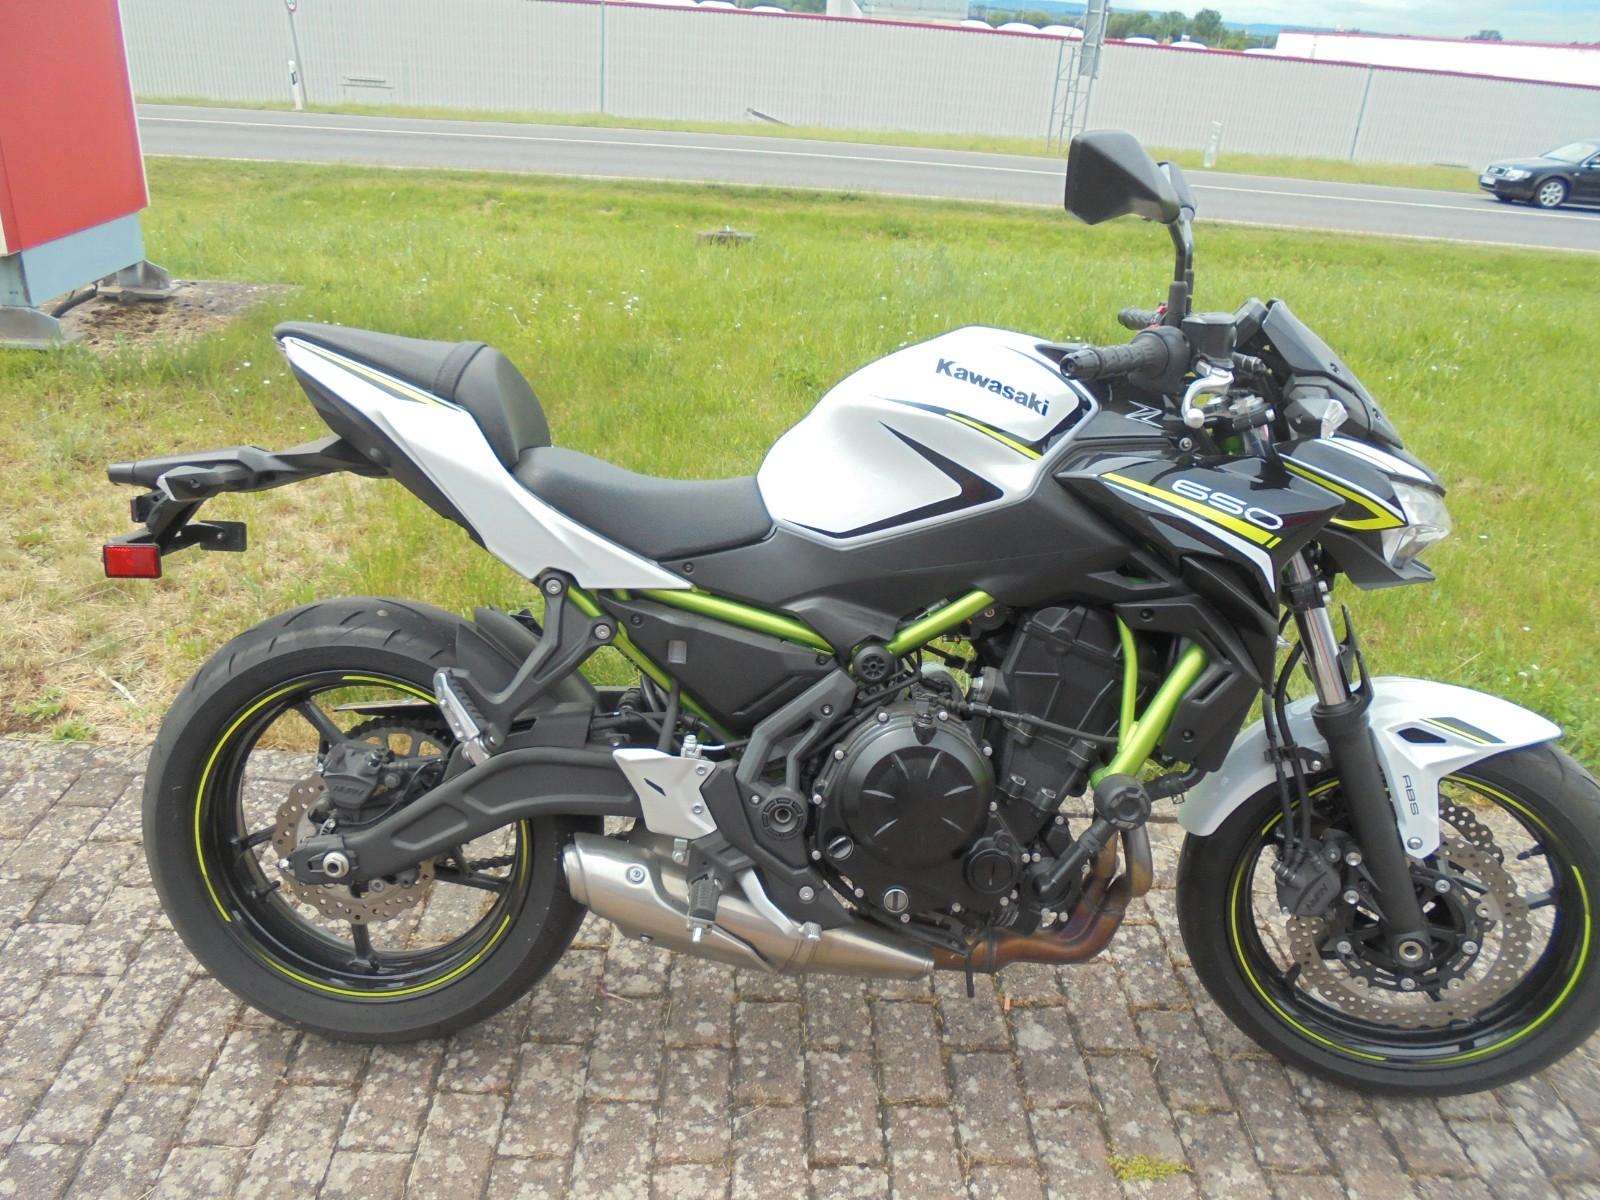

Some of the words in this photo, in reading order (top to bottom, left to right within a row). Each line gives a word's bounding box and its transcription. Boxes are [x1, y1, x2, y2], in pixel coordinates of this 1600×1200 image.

[936, 358, 1050, 417] Kawasaki
[1171, 479, 1284, 530] 650
[1402, 774, 1420, 816] ABS
